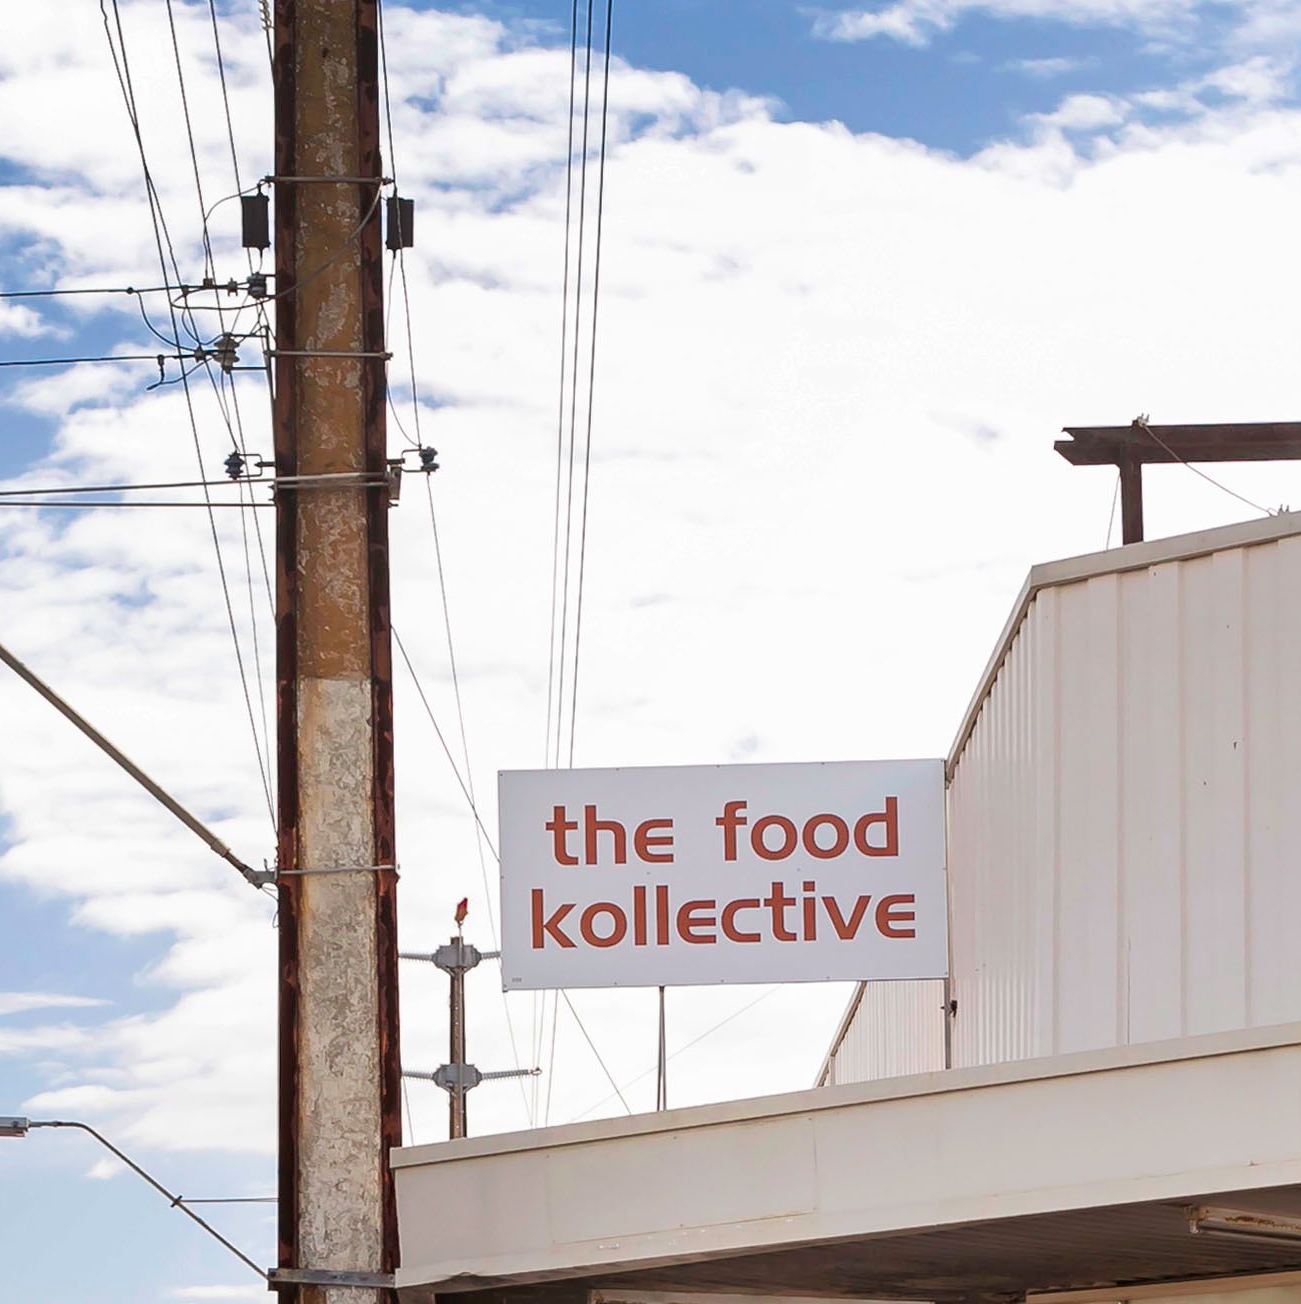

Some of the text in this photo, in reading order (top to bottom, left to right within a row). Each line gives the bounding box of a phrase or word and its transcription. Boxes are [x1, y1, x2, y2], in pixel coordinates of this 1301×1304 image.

[545, 795, 900, 867] the food
[530, 880, 917, 950] kollective
